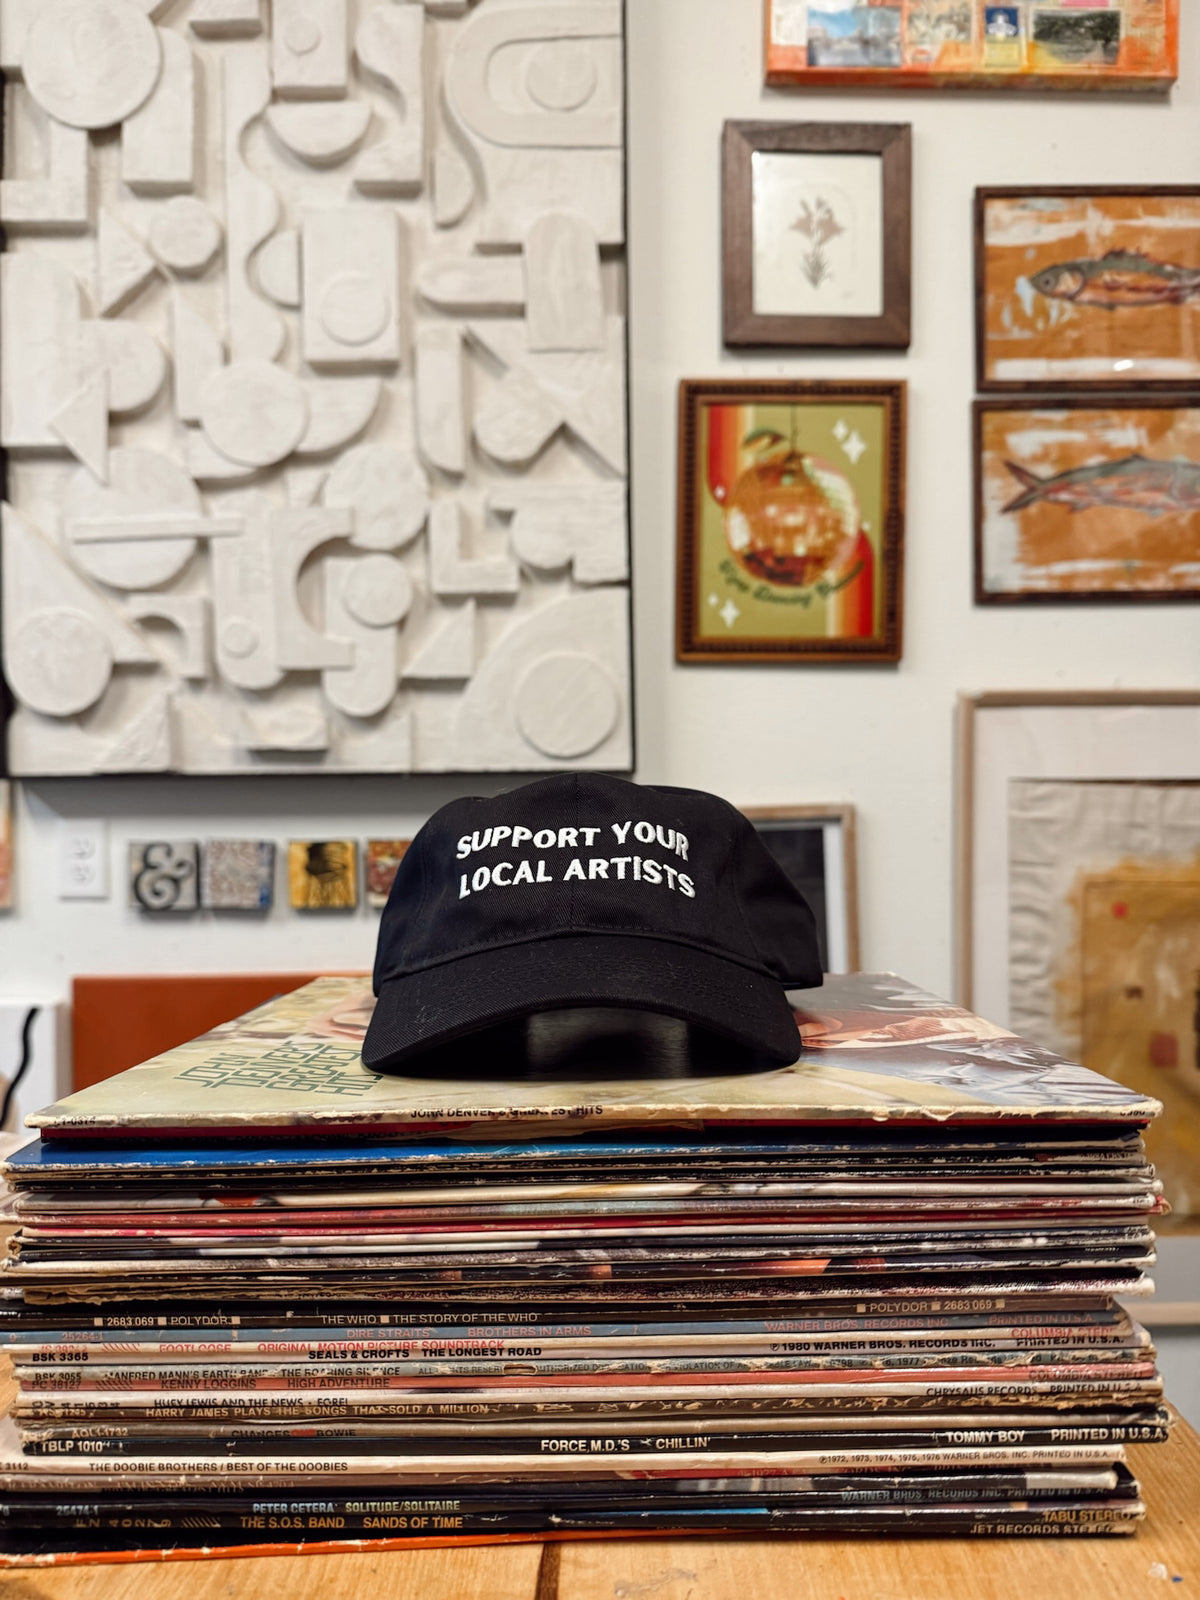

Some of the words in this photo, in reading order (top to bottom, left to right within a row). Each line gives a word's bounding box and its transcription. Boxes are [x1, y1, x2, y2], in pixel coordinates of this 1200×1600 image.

[456, 826, 601, 860] SUPPORT
[611, 821, 689, 861] YOUR
[458, 860, 553, 900] LOCAL
[562, 856, 696, 898] ARTISTS
[576, 1104, 604, 1115] HITS
[869, 1302, 928, 1313] POLYDOR
[944, 1301, 970, 1311] 2683
[973, 1300, 992, 1310] 069
[107, 1317, 132, 1327] 2683
[134, 1316, 154, 1326] 069
[171, 1315, 227, 1326] POLYDOR
[321, 1315, 345, 1324] THE
[347, 1315, 377, 1324] WHO
[393, 1314, 418, 1324] THE
[419, 1313, 461, 1324] STORY
[461, 1313, 480, 1323] OF
[483, 1313, 507, 1323] THE
[508, 1312, 538, 1322] WHO
[346, 1329, 375, 1339] DIRE
[378, 1327, 430, 1338] STRAITS
[467, 1327, 536, 1337] BROTHERS
[539, 1327, 553, 1337] IN
[555, 1326, 592, 1336] ARMS
[764, 1321, 821, 1332] WARNER
[864, 1318, 924, 1328] RECORDS
[32, 1353, 56, 1362] BSK
[59, 1352, 89, 1361] 3365
[308, 1350, 347, 1359] SEALS
[350, 1350, 358, 1359] &
[361, 1349, 409, 1358] CROFTS
[422, 1348, 445, 1357] THE
[449, 1348, 503, 1357] LONGEST
[508, 1347, 542, 1356] ROAD
[782, 1342, 810, 1350] 1980
[813, 1340, 866, 1350] WARNER
[869, 1340, 906, 1348] BROS.
[909, 1338, 967, 1348] RECORDS
[1016, 1336, 1070, 1346] PRINTED
[1072, 1335, 1085, 1345] IN
[1088, 1334, 1124, 1343] U.S.A.
[257, 1342, 312, 1351] ORIGINAL
[318, 1342, 364, 1351] MOTION
[367, 1341, 418, 1350] PICTURE
[421, 1340, 504, 1350] SOUNDTRACK
[281, 1369, 301, 1377] THE
[161, 1380, 200, 1389] KENNY
[204, 1378, 257, 1389] LOGGINS
[287, 1378, 316, 1388] HIGH
[320, 1377, 390, 1387] ADVENTURE
[186, 1398, 218, 1407] LEWIS
[221, 1398, 246, 1406] AND
[248, 1398, 269, 1406] THE
[271, 1398, 304, 1406] NEWS
[145, 1408, 184, 1418] HARRY
[190, 1408, 229, 1418] JAMES
[234, 1407, 271, 1417] PLAYS
[305, 1406, 347, 1416] SONGS
[389, 1406, 421, 1415] SOLD
[426, 1406, 434, 1415] A
[439, 1405, 489, 1415] MILLION
[41, 1441, 73, 1452] TBLP
[655, 1436, 711, 1449] CHILLIN'
[944, 1431, 993, 1443] TOMMY
[997, 1430, 1025, 1442] BOY
[1050, 1428, 1108, 1440] PRINTED
[1111, 1428, 1126, 1439] IN
[89, 1462, 110, 1471] THE
[113, 1462, 155, 1471] DOOBIE
[158, 1462, 217, 1471] BROTHERS
[226, 1462, 254, 1471] BEST
[256, 1462, 272, 1471] OF
[275, 1462, 296, 1471] THE
[299, 1462, 348, 1471] DOOBIES
[943, 1452, 980, 1460] WARNER
[1033, 1450, 1071, 1458] PRINTED
[1073, 1449, 1083, 1458] IN
[252, 1502, 288, 1513] PETER
[290, 1502, 334, 1513] CETERA
[345, 1500, 461, 1512] SOLITUDE/SOLITAIRE
[240, 1517, 265, 1528] THE
[268, 1517, 305, 1528] S.O.S.
[308, 1517, 345, 1528] BAND
[362, 1517, 407, 1528] SANDS
[410, 1517, 429, 1528] OF
[431, 1516, 463, 1528] TIME
[1043, 1511, 1076, 1523] TABU
[970, 1524, 994, 1534] JET
[996, 1524, 1060, 1534] RECORDS
